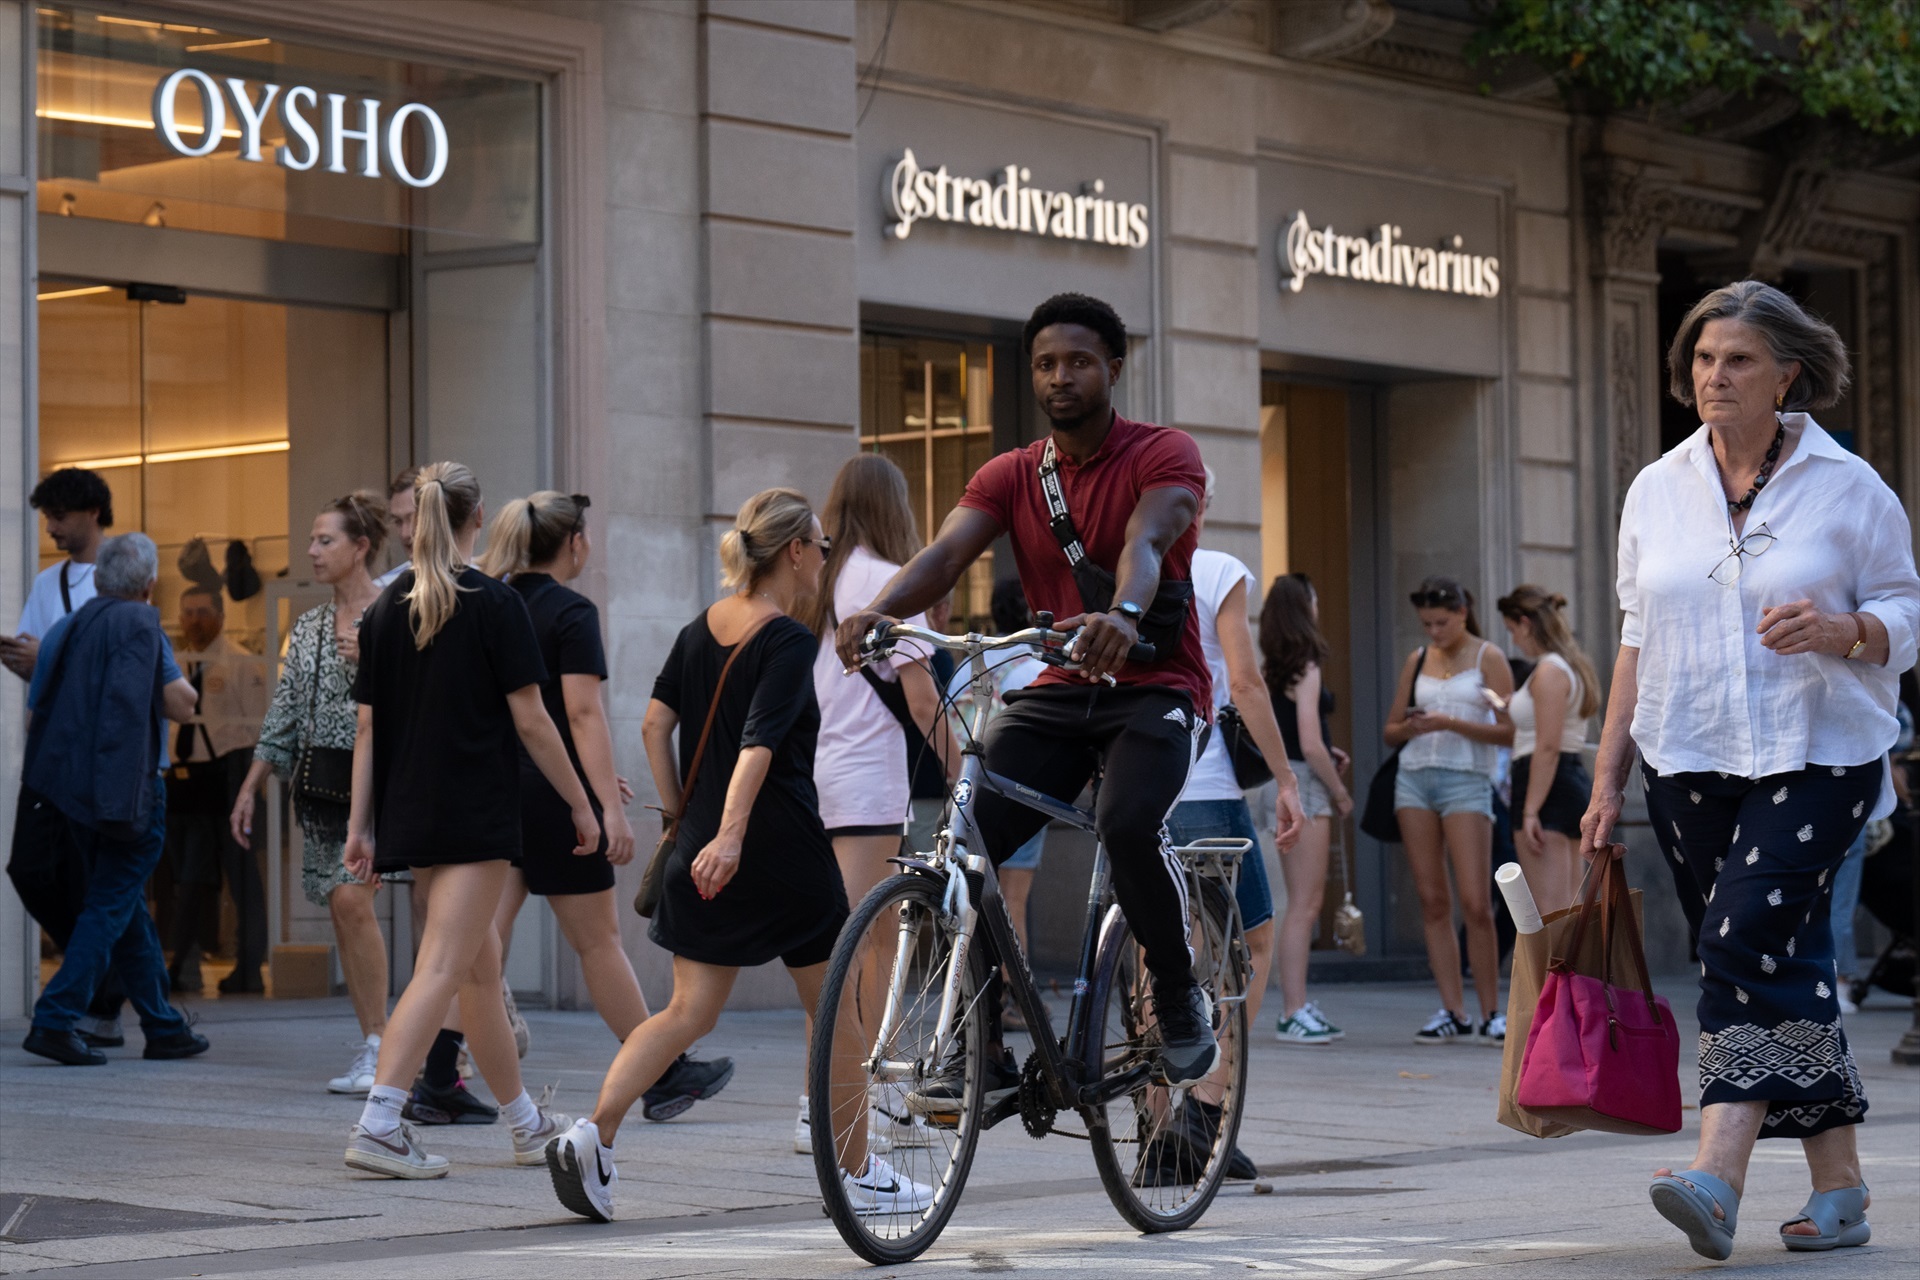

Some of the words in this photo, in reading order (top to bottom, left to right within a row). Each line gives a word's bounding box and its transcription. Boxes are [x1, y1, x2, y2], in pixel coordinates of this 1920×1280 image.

[156, 68, 448, 188] OYSHO
[912, 163, 1149, 249] stradivarius
[1305, 223, 1500, 298] stradivarius
